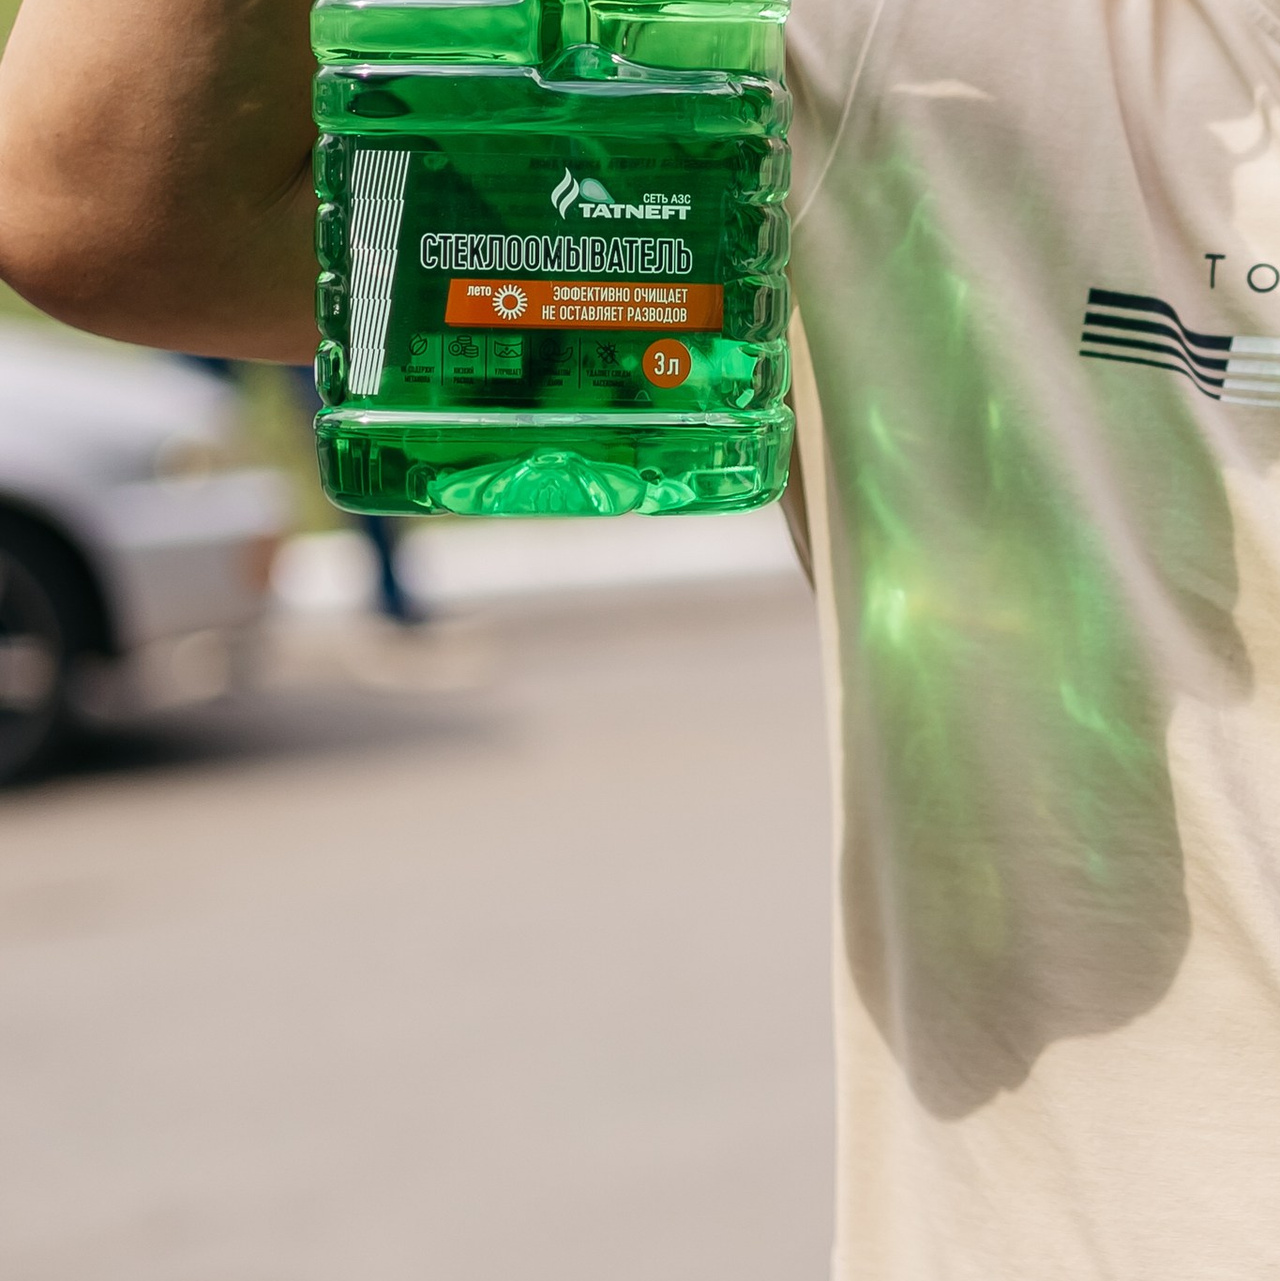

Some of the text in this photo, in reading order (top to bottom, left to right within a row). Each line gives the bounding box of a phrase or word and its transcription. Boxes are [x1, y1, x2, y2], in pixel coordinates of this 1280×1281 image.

[643, 193, 691, 204] СЕТЬ АЗС
[578, 203, 692, 220] TATNEFT
[420, 233, 693, 274] СТЕКЛООМЫВАТЕЛЬ
[467, 285, 492, 297] лето
[553, 286, 689, 304] ЭФФЕКТИВНО ОЧИЩАЕТ
[542, 305, 688, 324] НЕ ОСТАВЛЯЕТ РАЗВОДОВ
